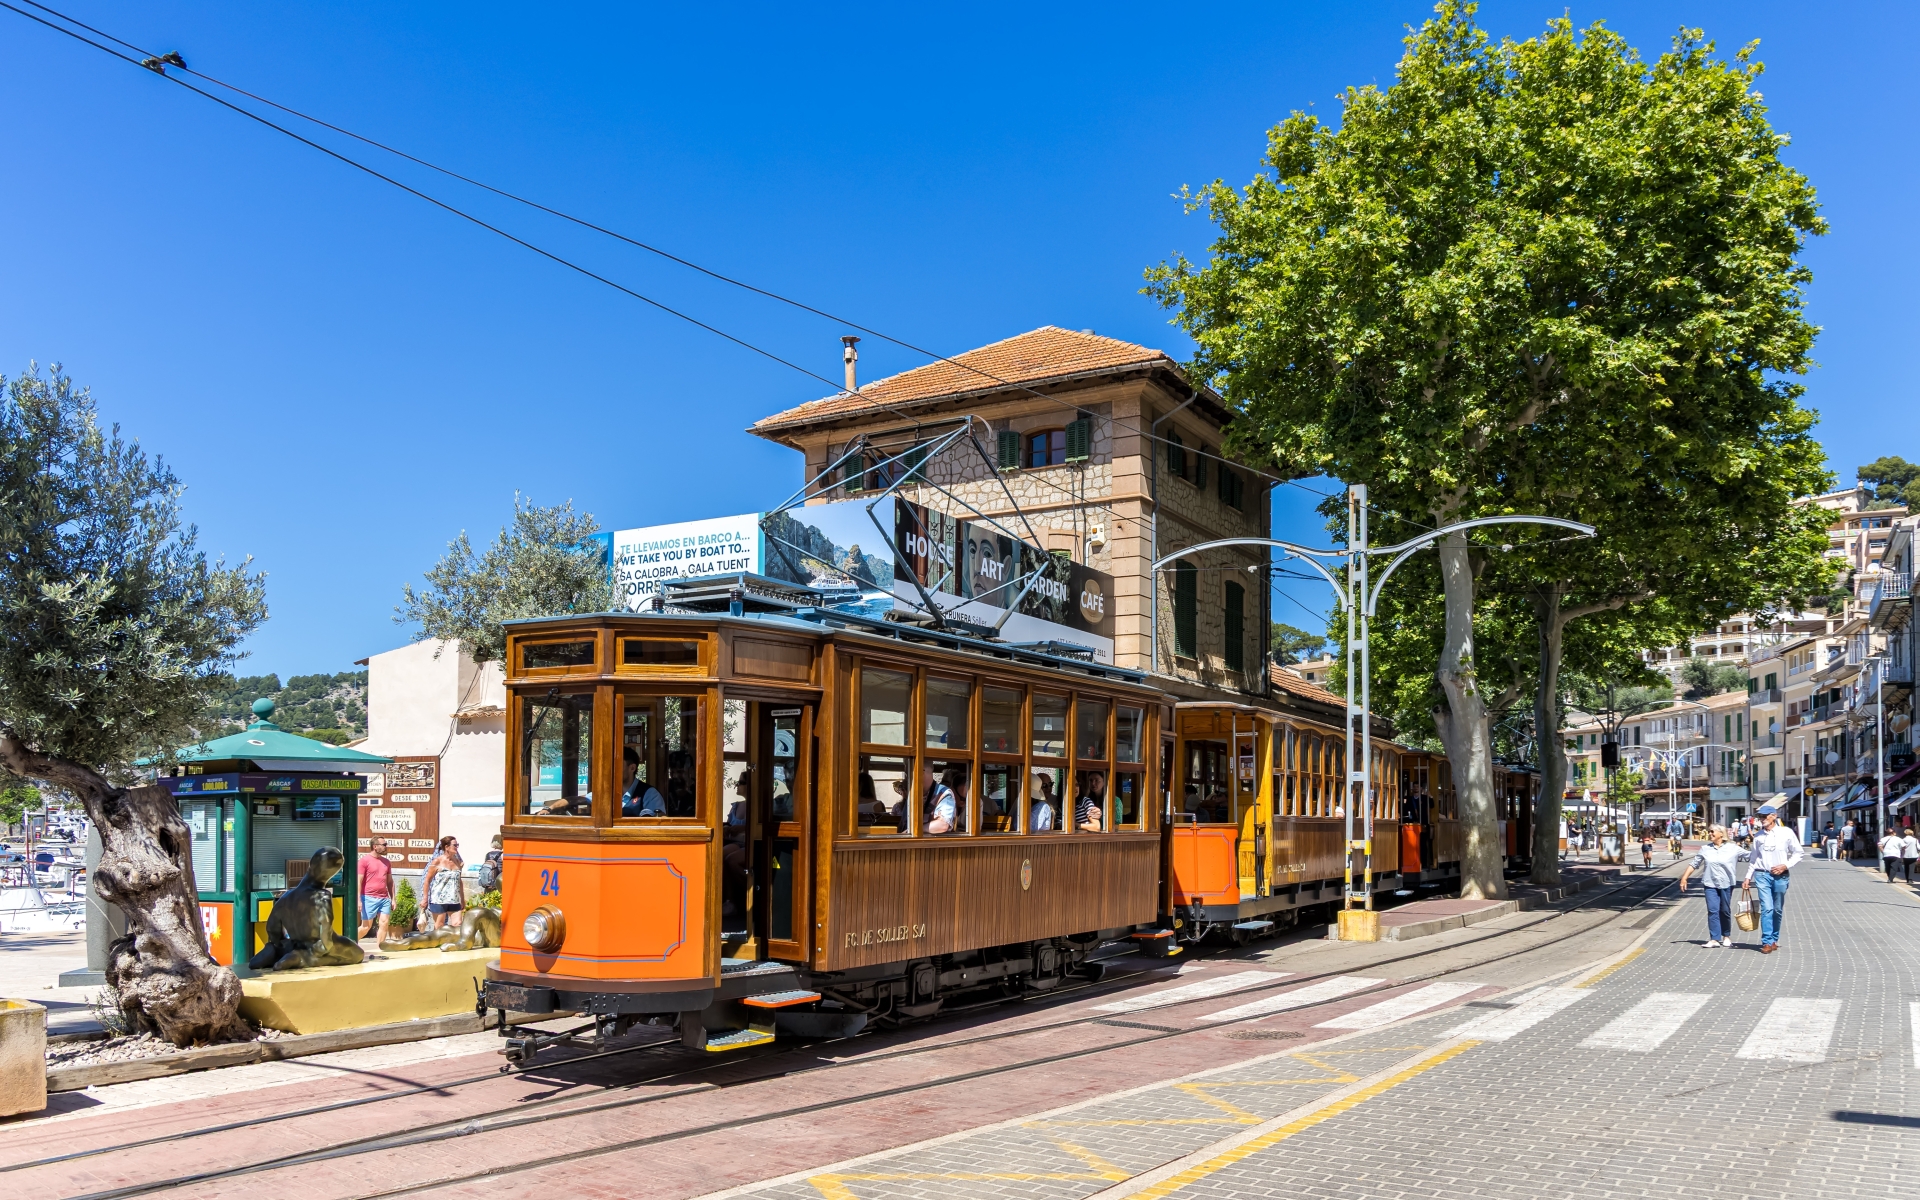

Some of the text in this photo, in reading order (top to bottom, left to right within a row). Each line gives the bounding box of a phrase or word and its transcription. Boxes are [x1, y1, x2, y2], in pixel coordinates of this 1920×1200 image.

[620, 531, 750, 554] TE LLEVAMOS EN BARCO A...
[621, 543, 750, 566] WE TAKE YOU BY BOAT TO...
[905, 531, 954, 567] HOUSE
[620, 571, 632, 582] SA
[634, 565, 679, 580] CALOBRA
[717, 557, 750, 571] TUENT
[980, 557, 1004, 582] ART
[1080, 588, 1104, 614] CAFÉ
[301, 780, 322, 790] RASCA
[323, 780, 331, 789] EL
[331, 780, 360, 789] MOMENTO
[541, 869, 560, 897] 24
[861, 930, 874, 946] DE
[876, 926, 909, 944] SOLLER
